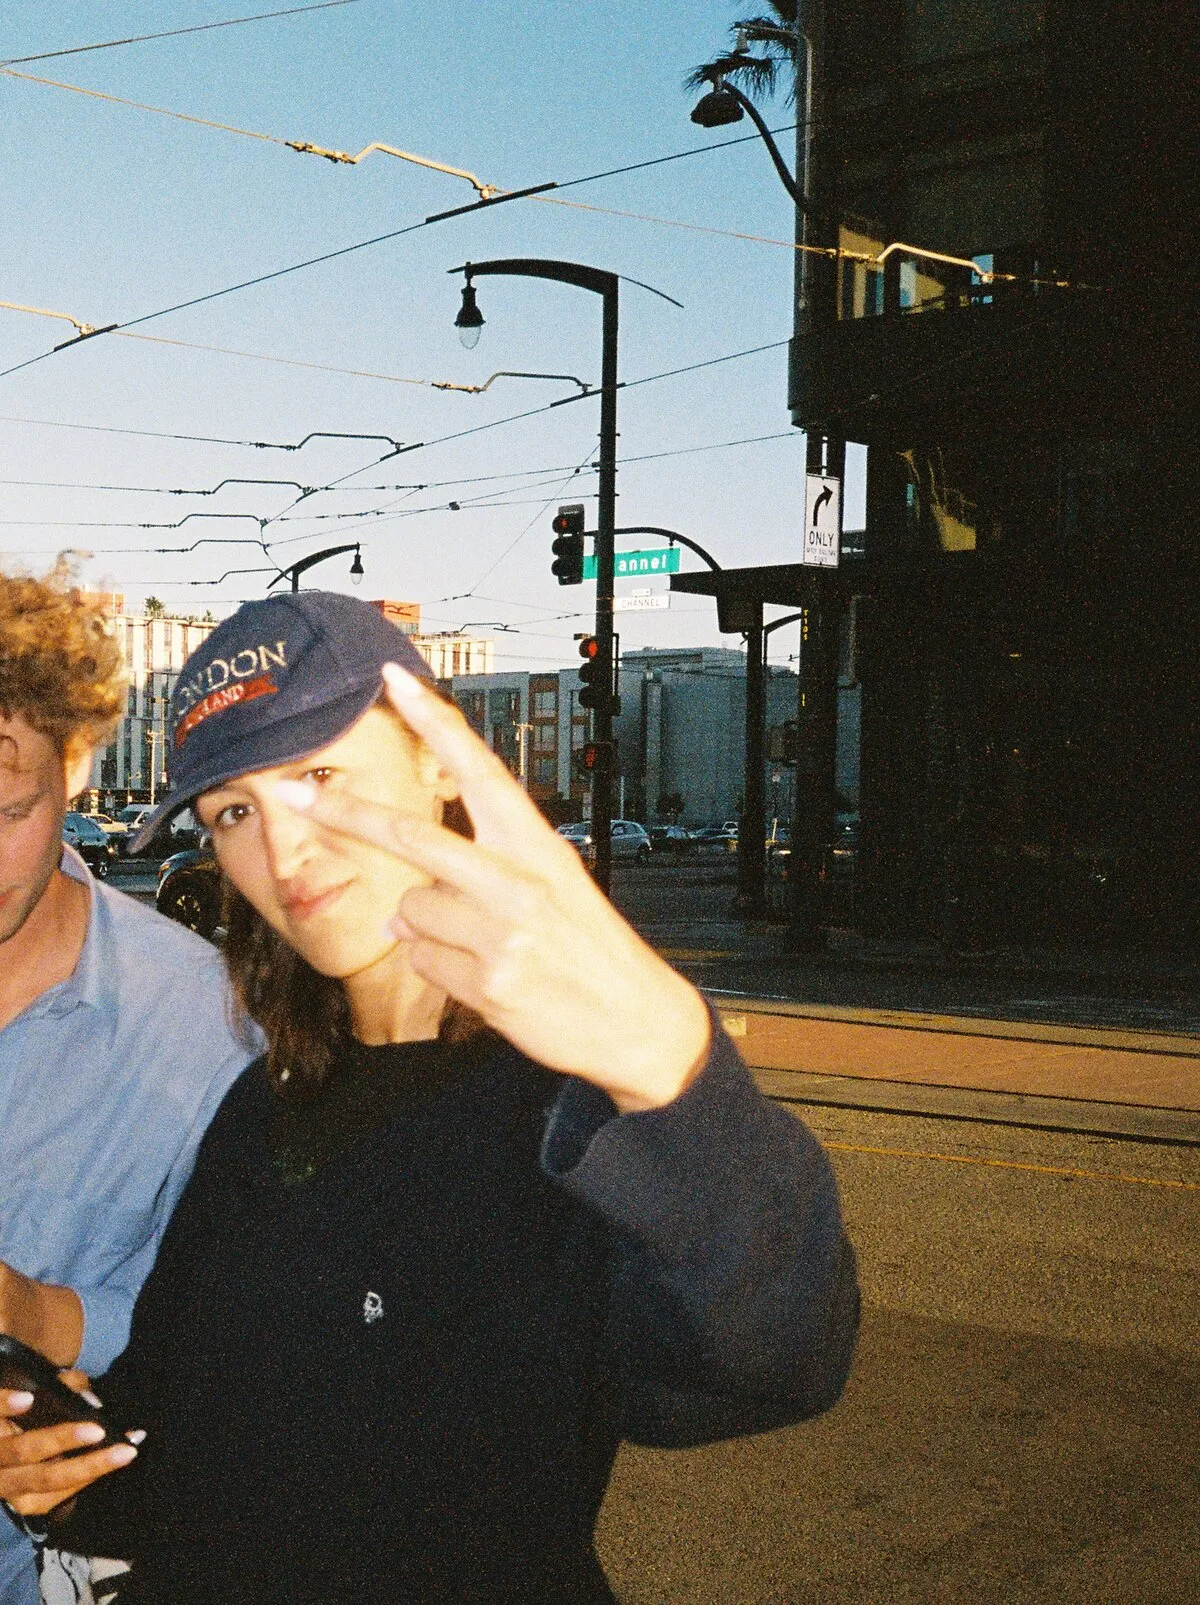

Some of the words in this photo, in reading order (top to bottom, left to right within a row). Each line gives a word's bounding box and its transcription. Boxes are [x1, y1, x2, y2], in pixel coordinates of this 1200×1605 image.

[809, 530, 835, 547] ONLY
[618, 554, 667, 572] annel
[621, 597, 661, 609] CHANNEL
[174, 641, 288, 728] ONDON
